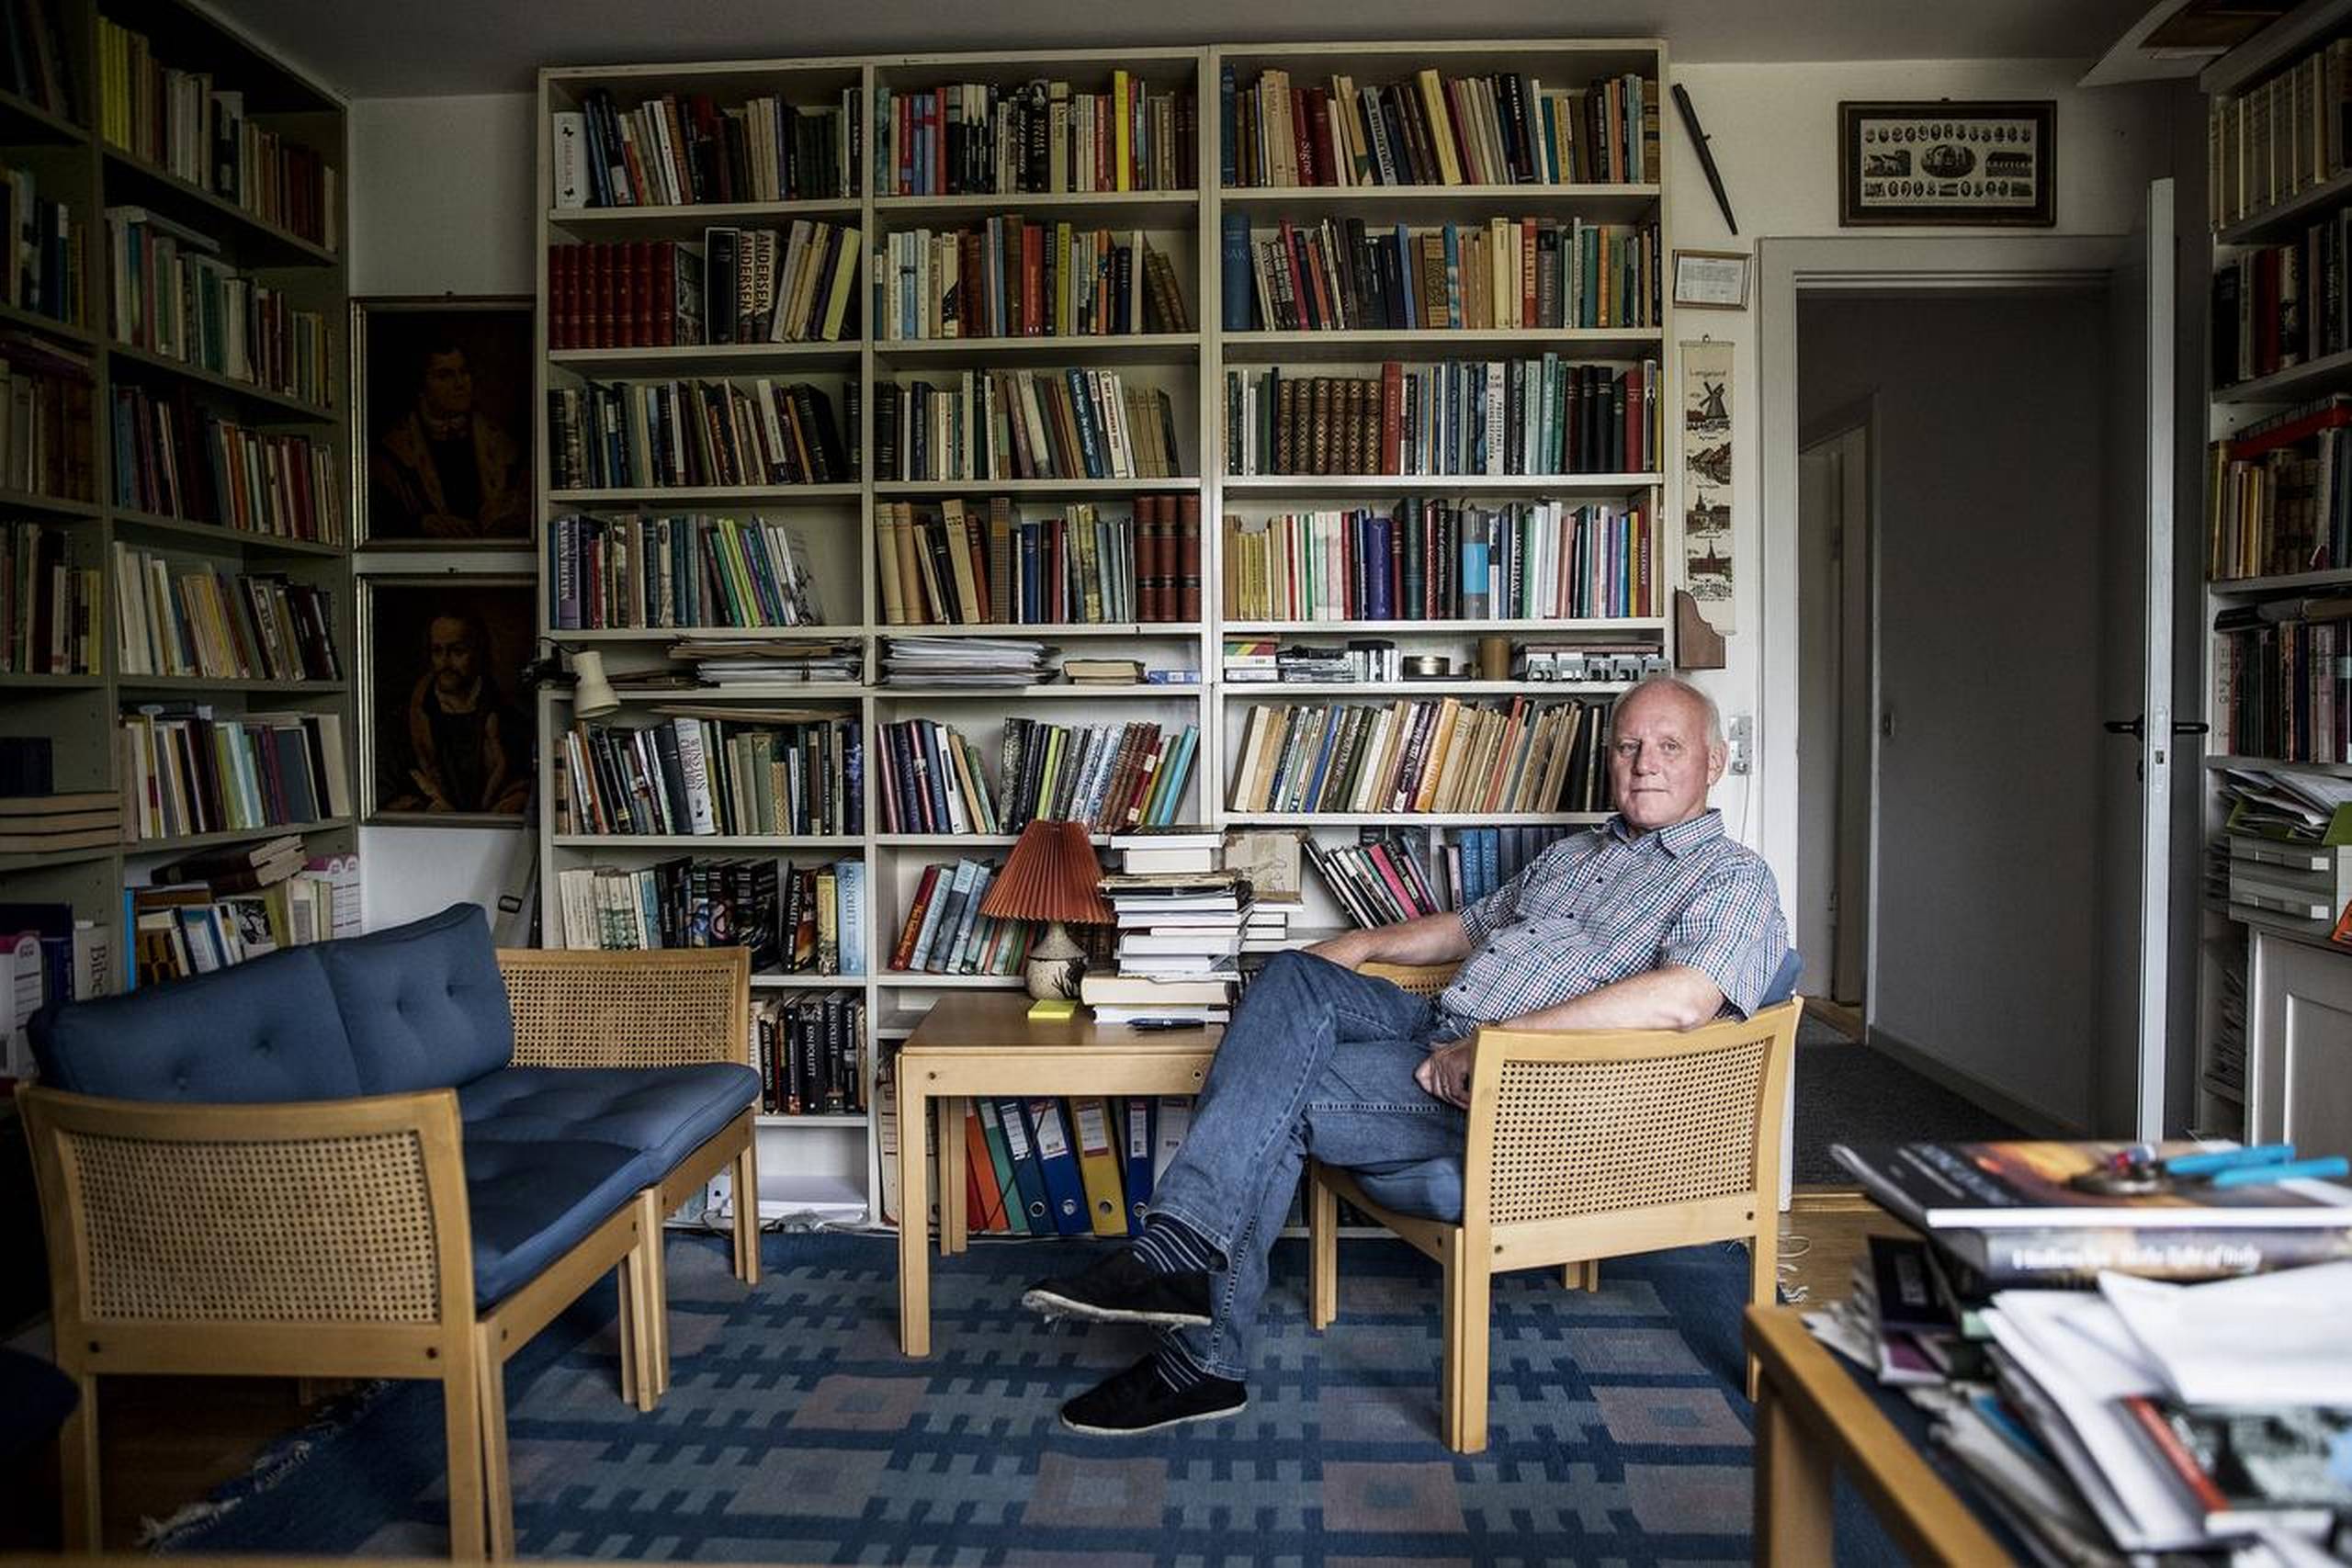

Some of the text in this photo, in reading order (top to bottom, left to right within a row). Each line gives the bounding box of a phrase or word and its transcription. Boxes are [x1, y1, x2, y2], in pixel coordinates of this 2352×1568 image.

[1299, 140, 1312, 175] Signe
[740, 235, 752, 309] ANDERSEN
[756, 234, 770, 308] ANDERSEN
[558, 521, 570, 601] KAREN BLIXEN
[687, 738, 707, 791] WINSTON
[806, 1024, 816, 1077] KEN FOLLETT
[828, 1005, 838, 1055] KEN FOLLETT
